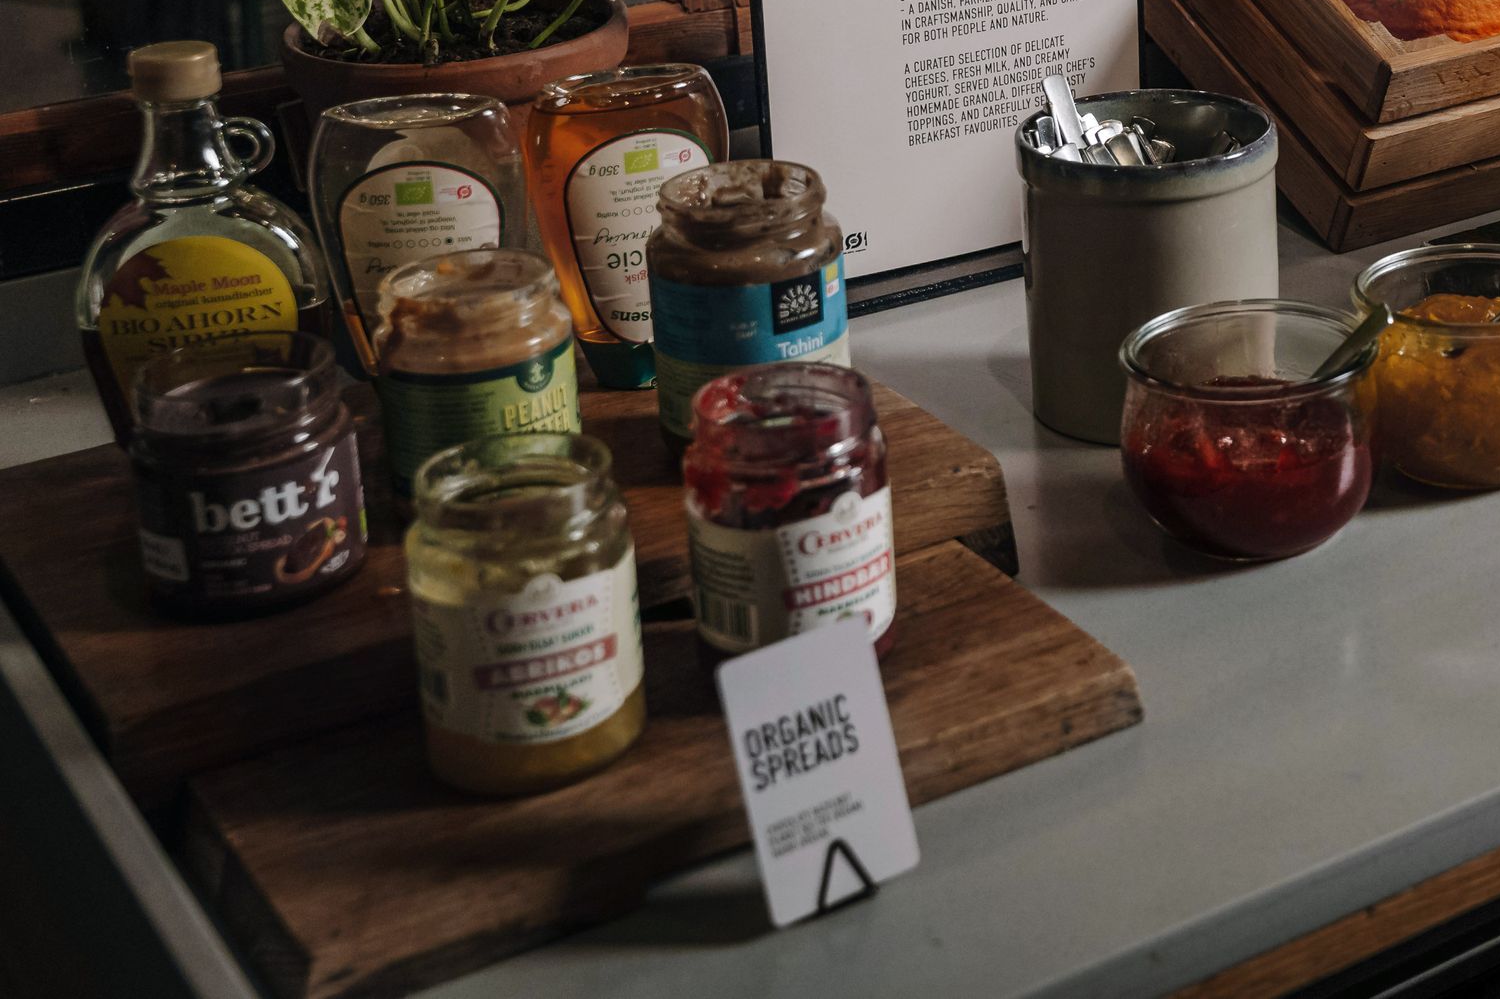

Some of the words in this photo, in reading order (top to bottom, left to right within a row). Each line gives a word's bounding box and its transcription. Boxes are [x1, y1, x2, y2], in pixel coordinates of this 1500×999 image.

[901, 19, 911, 31] IN
[915, 6, 994, 29] CRAFTSMANSHIP,
[908, 4, 914, 15] A
[902, 32, 920, 45] FOR
[924, 26, 948, 42] BOTH
[951, 21, 986, 37] PEOPLE
[990, 17, 1008, 30] AND
[1011, 10, 1048, 27] NATURE.
[904, 63, 910, 74] A
[914, 56, 955, 73] CURATED
[959, 46, 1007, 64] SELECTION
[1011, 43, 1022, 55] OF
[1025, 35, 1065, 53] DELICATE
[905, 74, 949, 89] CHEESES,
[952, 65, 981, 80] FRESH
[985, 60, 1011, 75] MILK,
[1014, 55, 1032, 69] AND
[1035, 48, 1070, 65] CREAMY
[906, 85, 951, 103] YOGHURT,
[954, 78, 989, 94] SERVED
[993, 68, 1041, 87] ALONGSIDE
[1045, 64, 1063, 76] OUR
[1066, 57, 1095, 72] CHEF'S
[907, 99, 960, 118] HOMEMADE
[963, 90, 1008, 107] GRANOLA,
[1011, 81, 1045, 98] DIFFER
[1066, 73, 1086, 87] ASTY
[908, 115, 957, 132] TOPPINGS,
[961, 108, 980, 122] AND
[983, 98, 1031, 118] CAREFULLY
[908, 126, 961, 146] BREAKFAST
[964, 115, 1021, 135] FAVOURITES.
[589, 165, 597, 177] g
[599, 164, 620, 177] 350
[359, 193, 367, 204] g
[369, 194, 391, 205] 350
[607, 250, 643, 272] cie
[153, 280, 206, 296] Maple
[212, 274, 262, 289] Moon
[111, 318, 160, 335] BIO
[166, 301, 283, 332] AHORN
[777, 332, 824, 358] Tahini
[503, 384, 568, 431] PEANUT
[744, 694, 850, 758] ORGANIC
[752, 723, 860, 790] SPREADS
